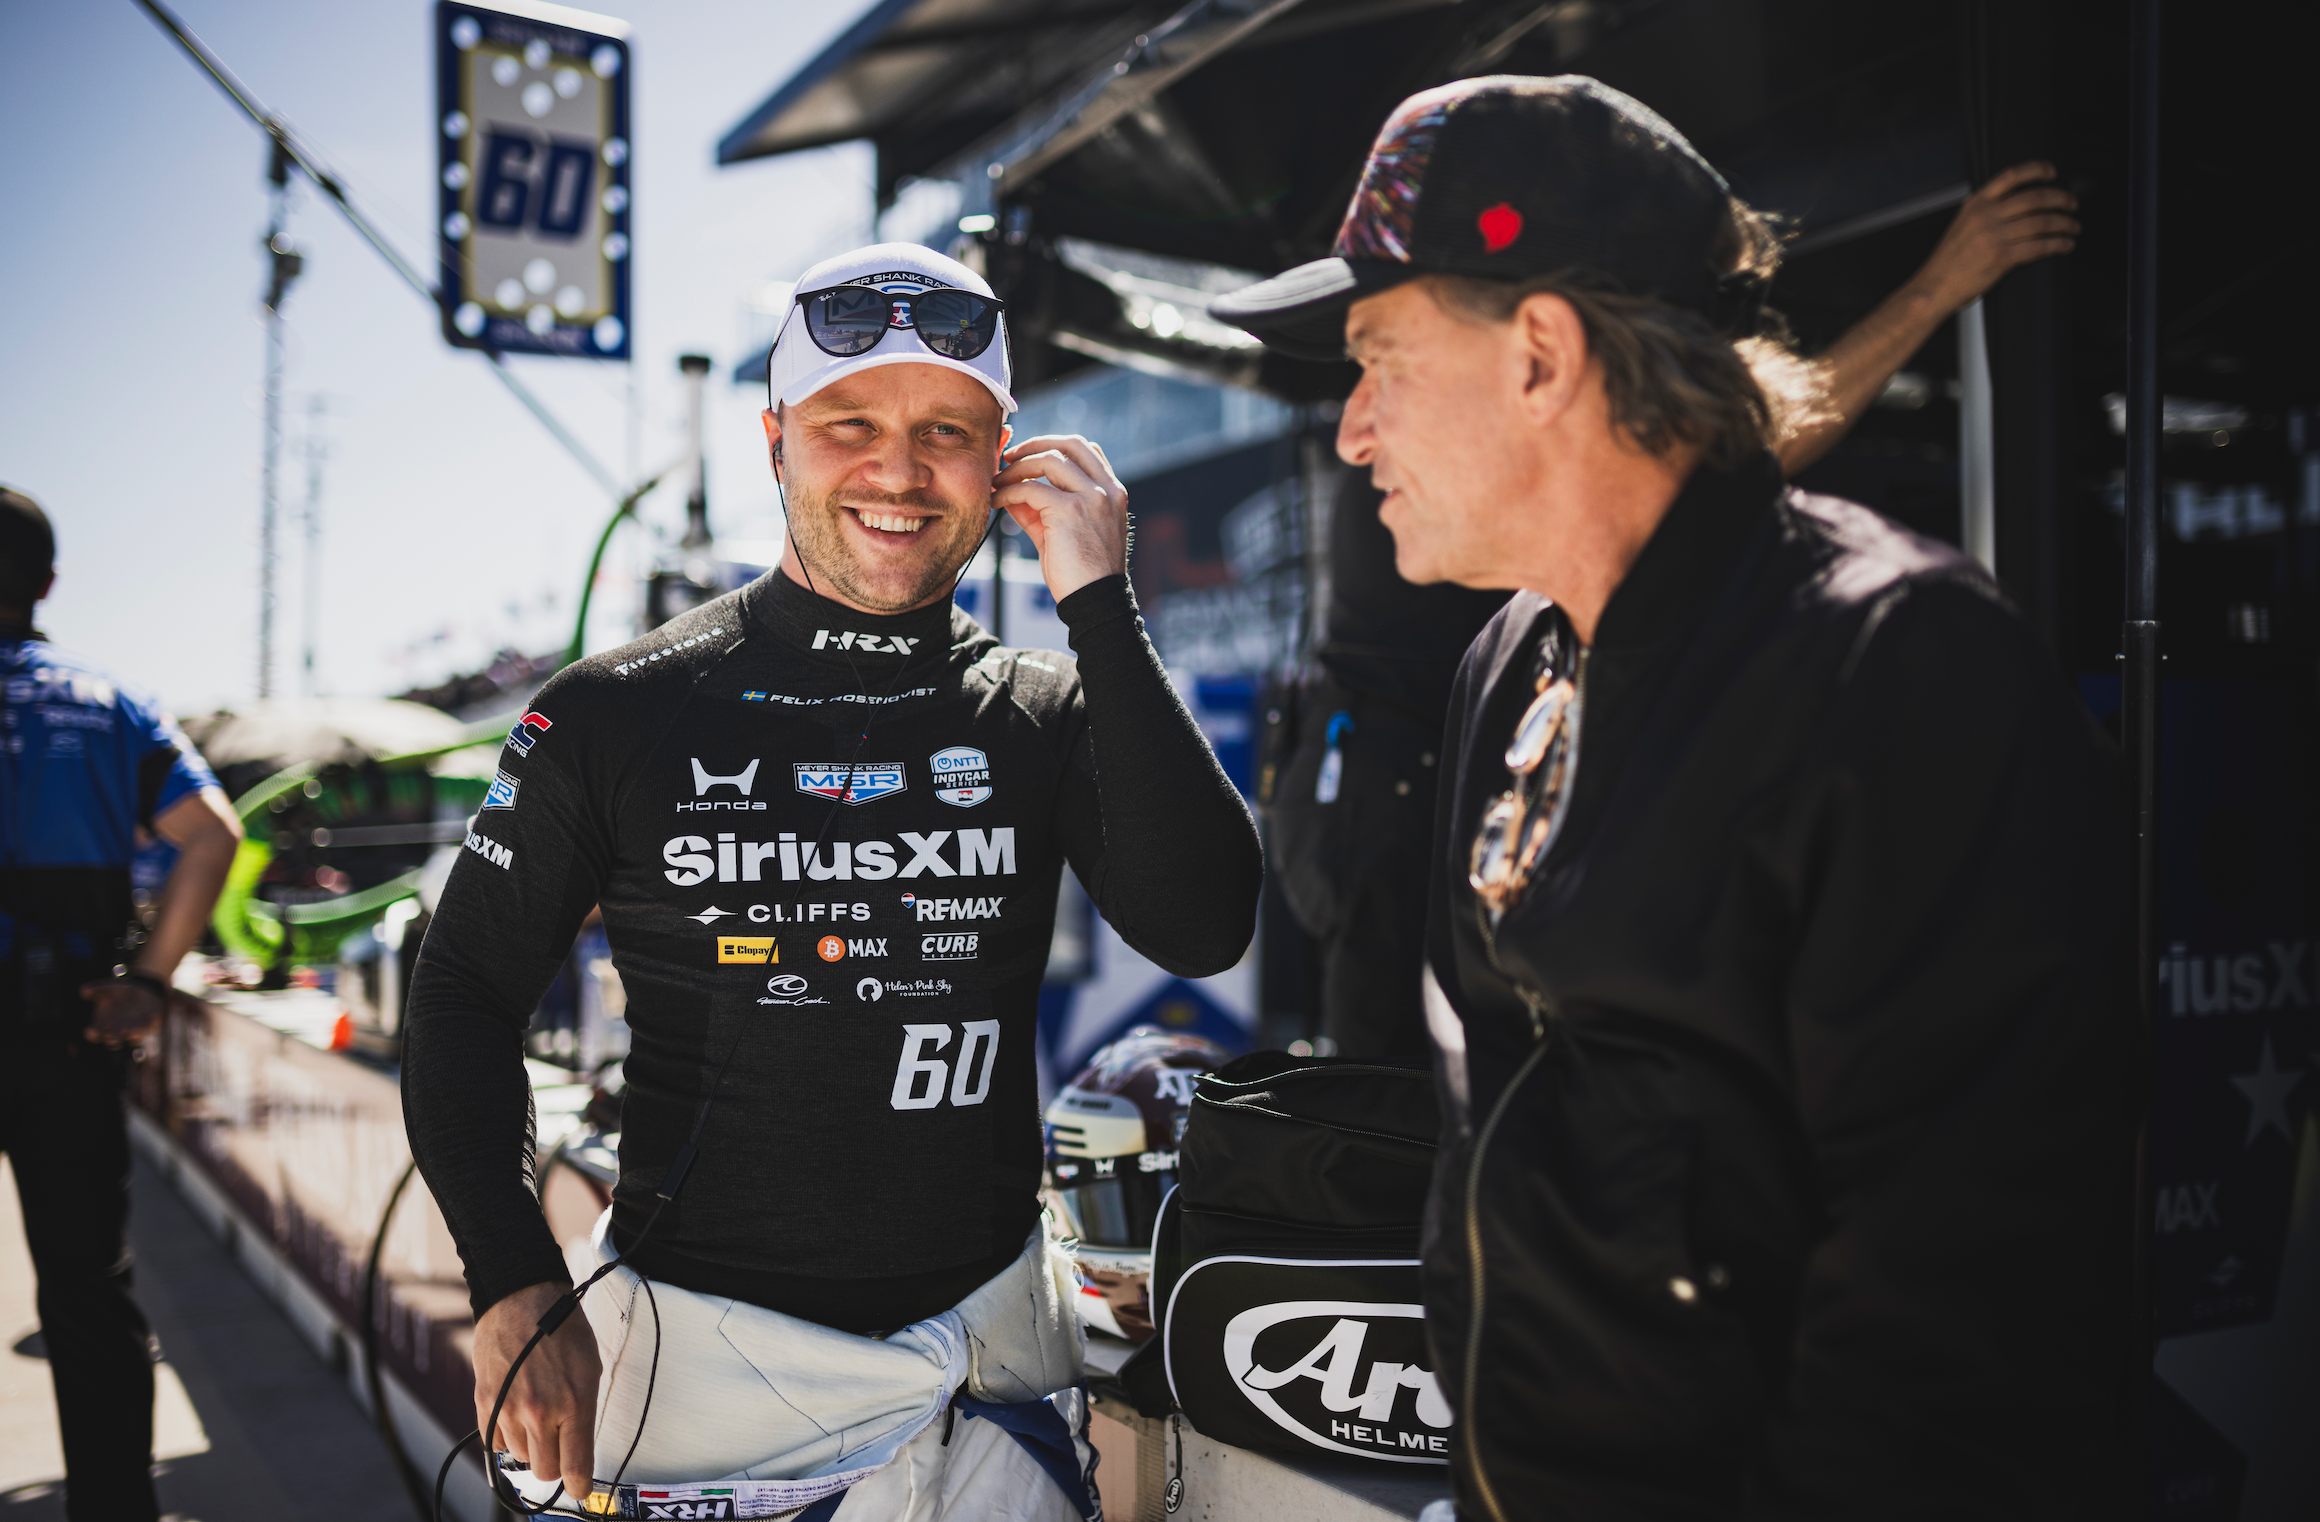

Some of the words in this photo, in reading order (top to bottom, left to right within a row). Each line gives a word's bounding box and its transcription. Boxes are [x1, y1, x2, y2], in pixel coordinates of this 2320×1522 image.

[473, 122, 597, 241] 60
[873, 273, 921, 282] SHANK
[811, 629, 920, 656] HRX
[770, 694, 824, 705] FELIX
[954, 756, 980, 767] NTT
[801, 773, 900, 787] MSR
[933, 770, 990, 784] INDYCAR
[946, 780, 979, 788] SERIES
[676, 800, 767, 812] Honda
[663, 827, 1016, 886] SiriusXM
[747, 903, 871, 923] CLIFFS
[737, 945, 769, 956] Clopay
[848, 938, 888, 957] MAX
[921, 935, 979, 953] CURB
[885, 981, 914, 991] Helen's
[915, 979, 934, 991] Pink
[936, 979, 952, 994] Sky
[890, 1019, 1000, 1110] 60
[1332, 1419, 1448, 1453] HELME
[647, 1501, 728, 1519] HRX
